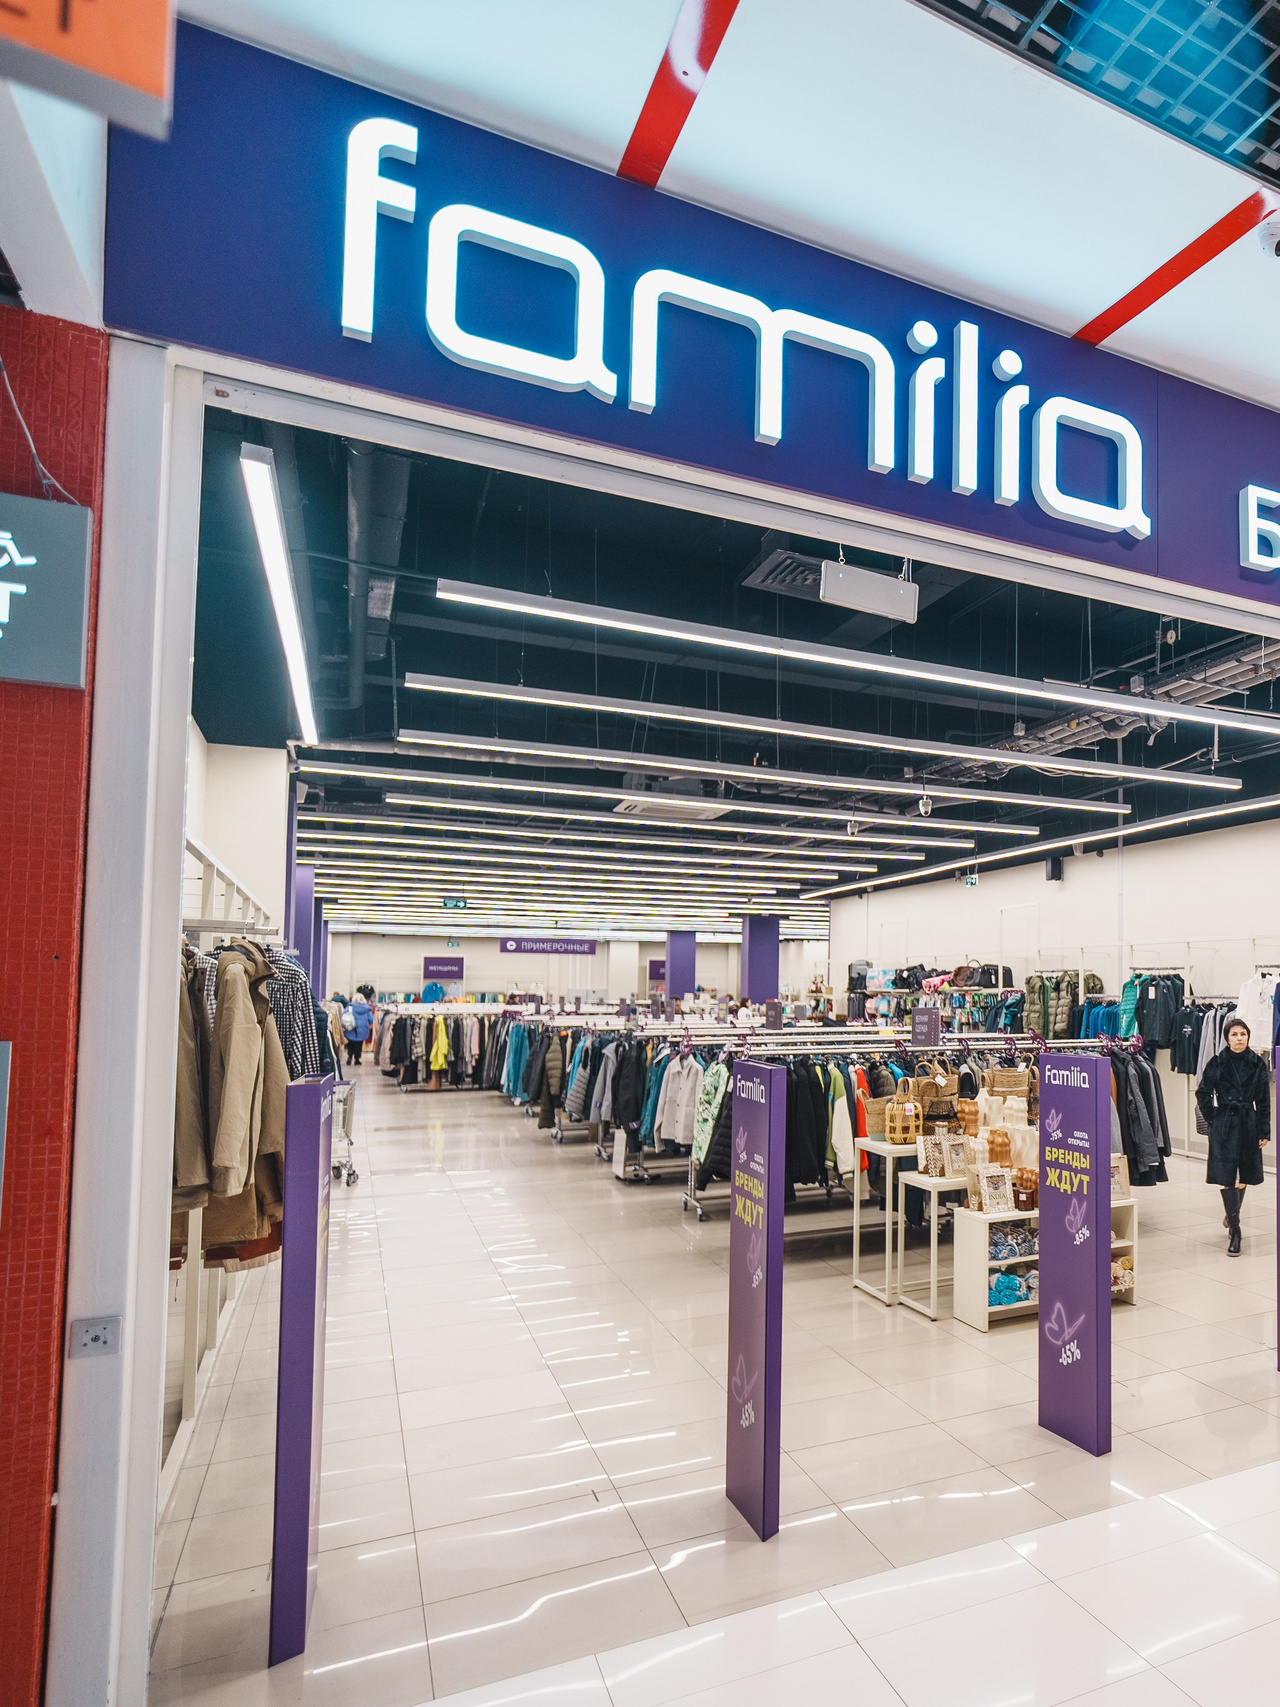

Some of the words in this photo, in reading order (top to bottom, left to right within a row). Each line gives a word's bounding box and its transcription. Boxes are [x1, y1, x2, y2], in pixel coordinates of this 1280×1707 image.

[341, 116, 1151, 540] familia
[521, 941, 590, 952] ПРИМЕРОЧНЫЕ
[736, 1073, 766, 1104] familia
[1045, 1064, 1089, 1088] familia
[1045, 1146, 1090, 1170] БРЕНДЫ
[735, 1169, 765, 1200] БРЕНДЫ
[1045, 1166, 1090, 1195] ЖДУТ
[735, 1193, 764, 1230] ЖДУТ
[1059, 1339, 1081, 1366] -65%
